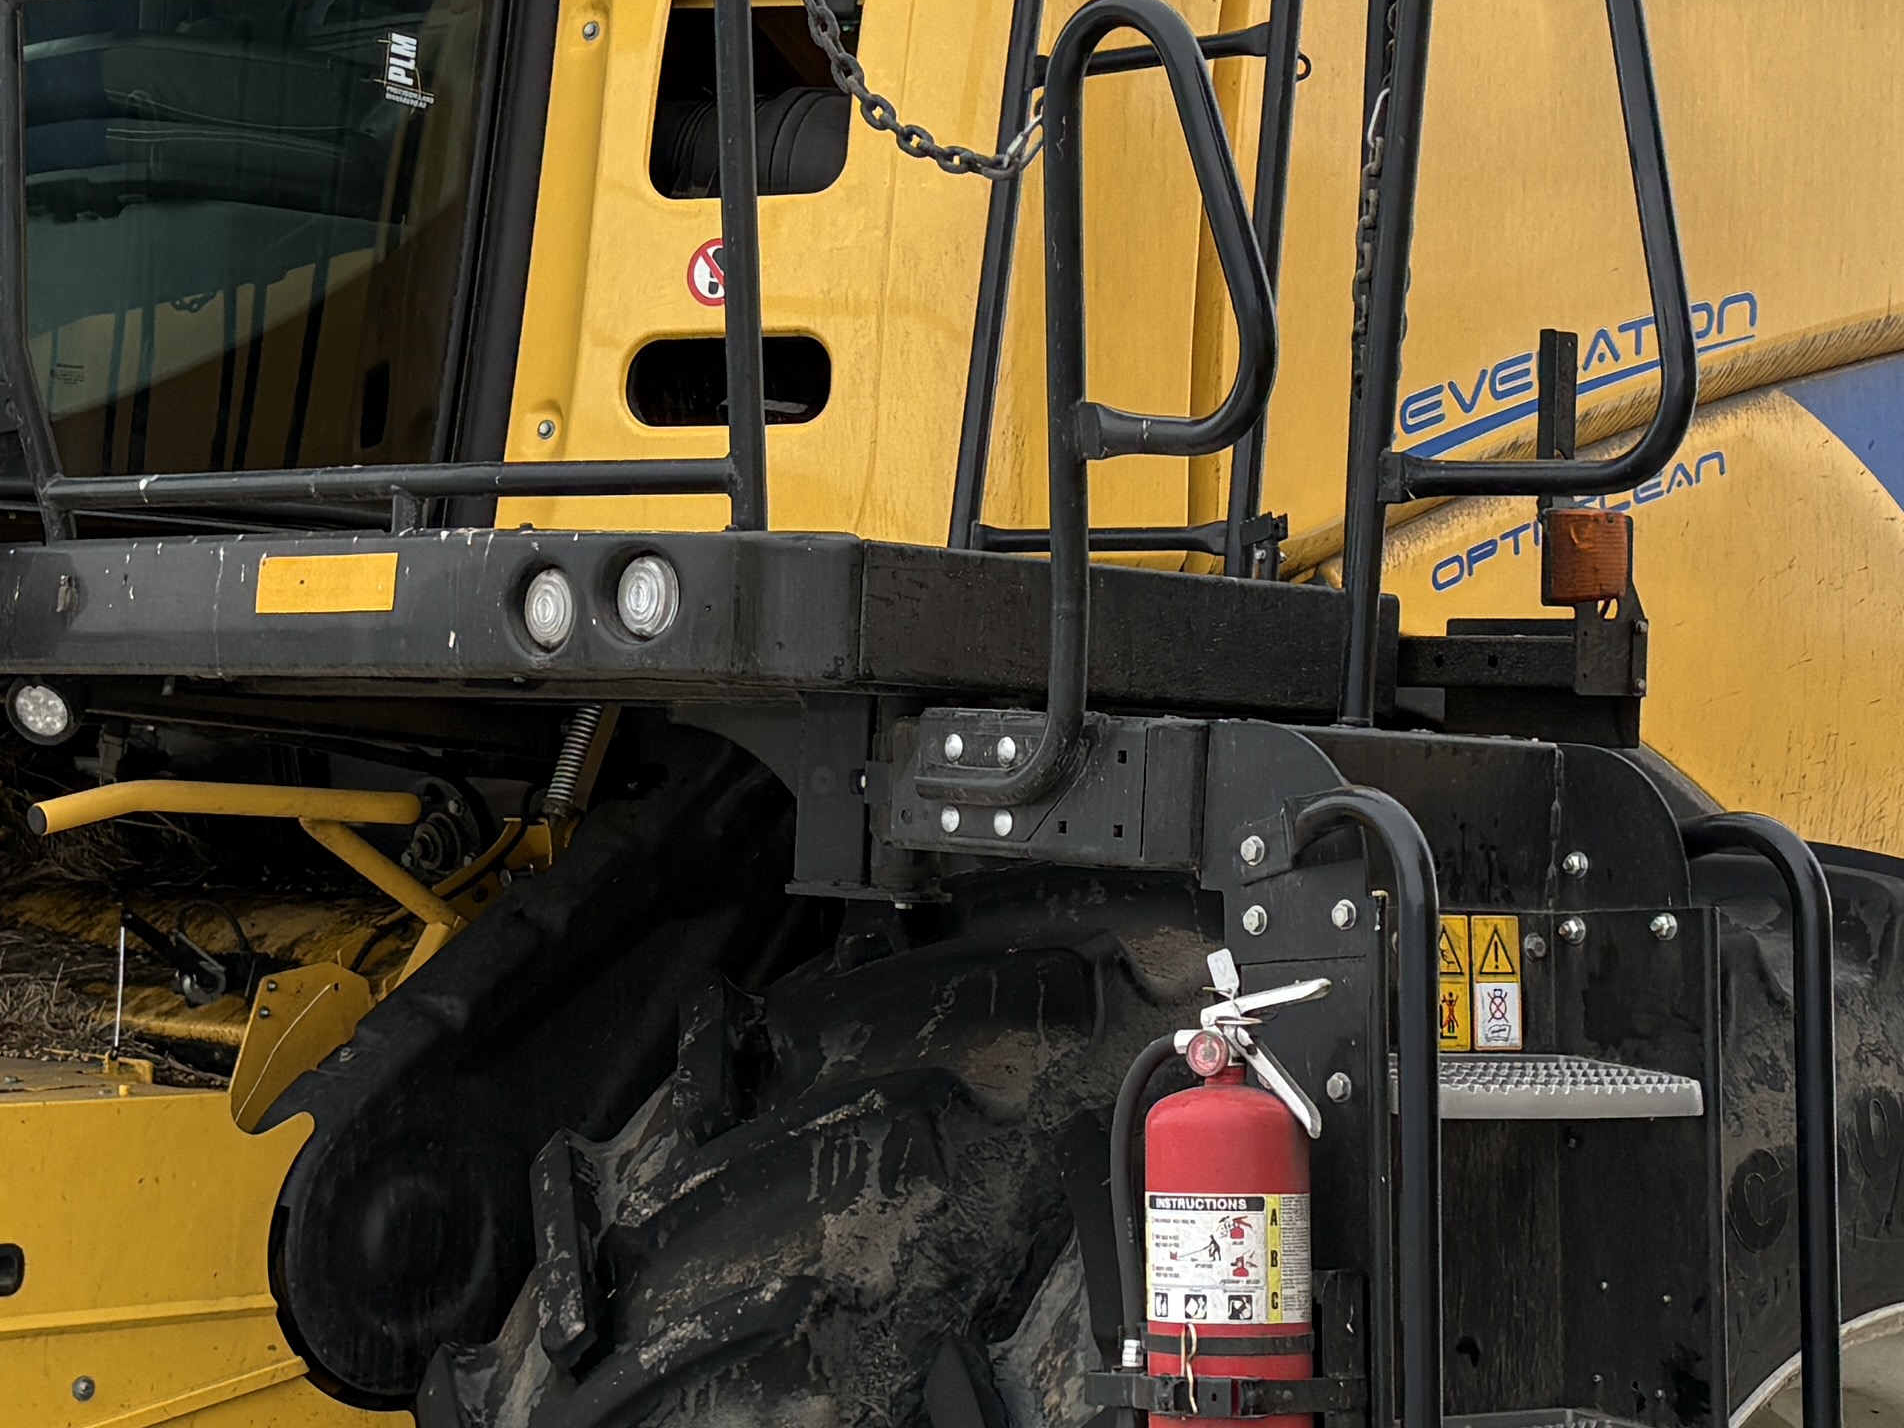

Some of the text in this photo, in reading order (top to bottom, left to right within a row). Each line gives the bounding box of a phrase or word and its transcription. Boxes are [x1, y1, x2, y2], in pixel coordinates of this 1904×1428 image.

[387, 32, 418, 86] PLM
[1155, 1198, 1248, 1210] INSTRUCTIONS
[1269, 1208, 1278, 1227] A
[1270, 1249, 1279, 1268] B
[1271, 1291, 1279, 1310] C
